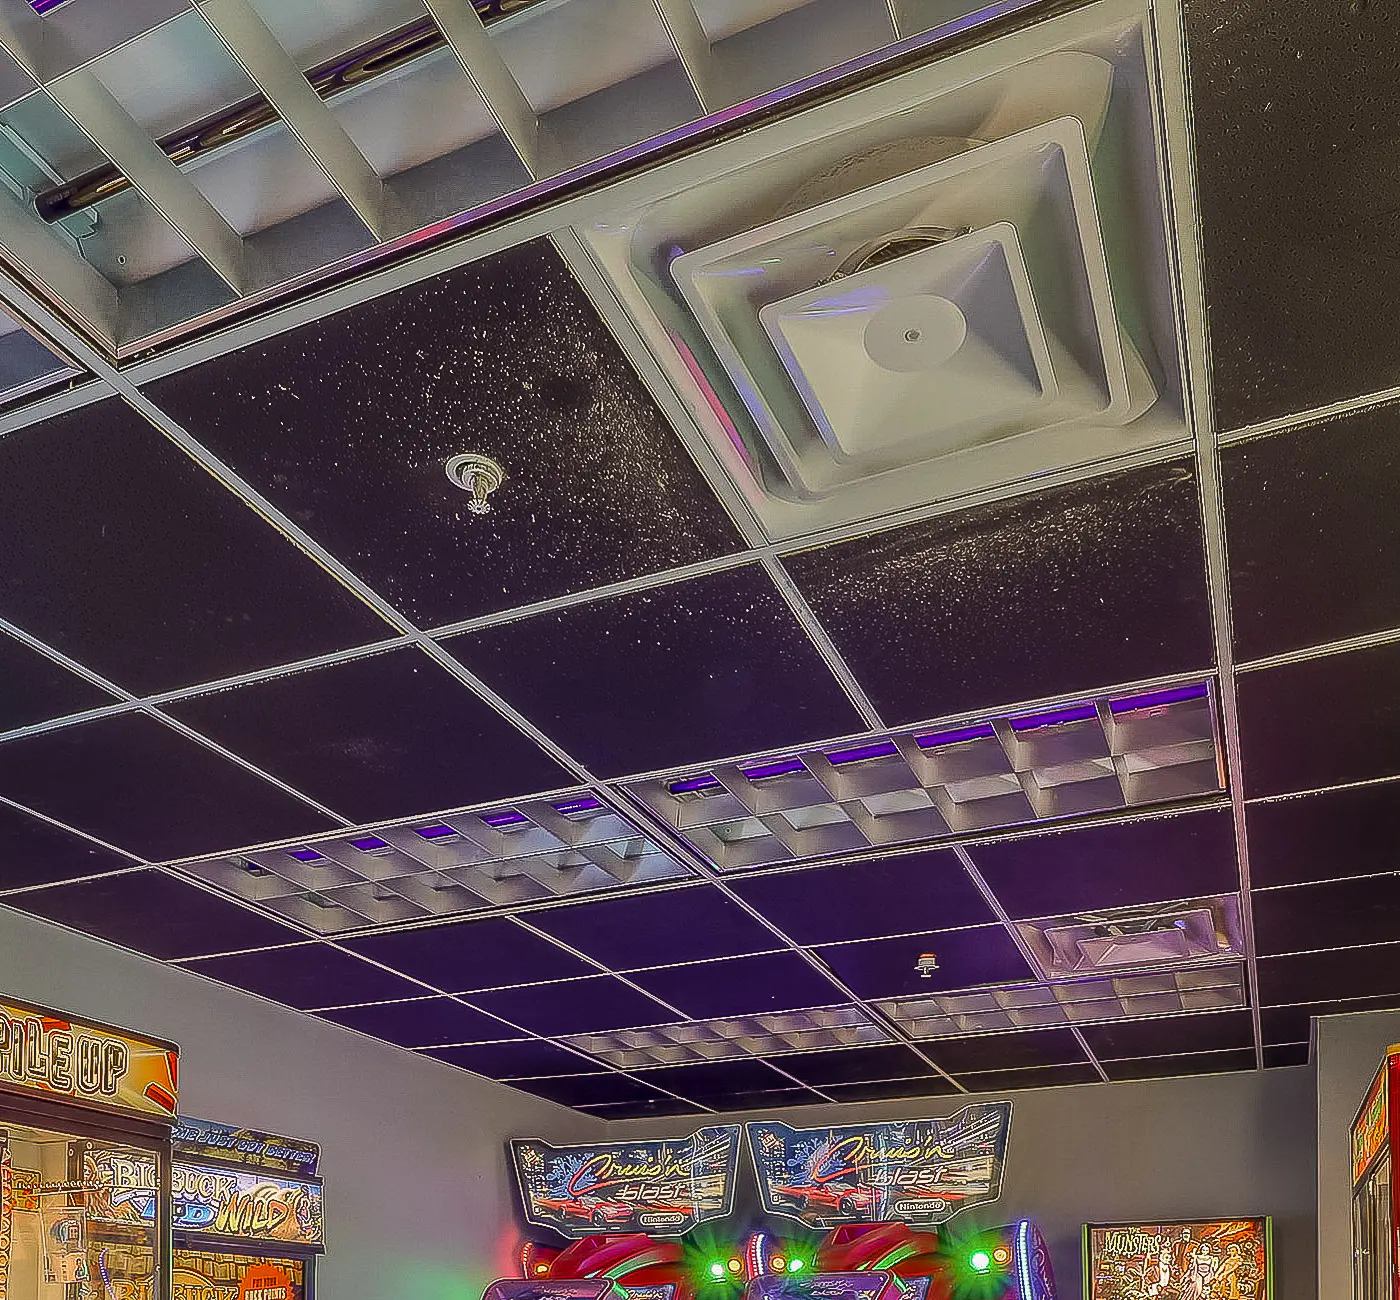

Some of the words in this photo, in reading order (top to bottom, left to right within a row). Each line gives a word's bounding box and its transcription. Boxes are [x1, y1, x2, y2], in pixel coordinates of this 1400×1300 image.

[171, 1169, 238, 1202] BUCK
[874, 1166, 951, 1186] blast
[614, 1183, 687, 1200] blast
[215, 1191, 290, 1232] WILD
[899, 1201, 942, 1211] Nintendo
[643, 1214, 682, 1224] Nintendo
[1104, 1231, 1161, 1257] MUNSTERS
